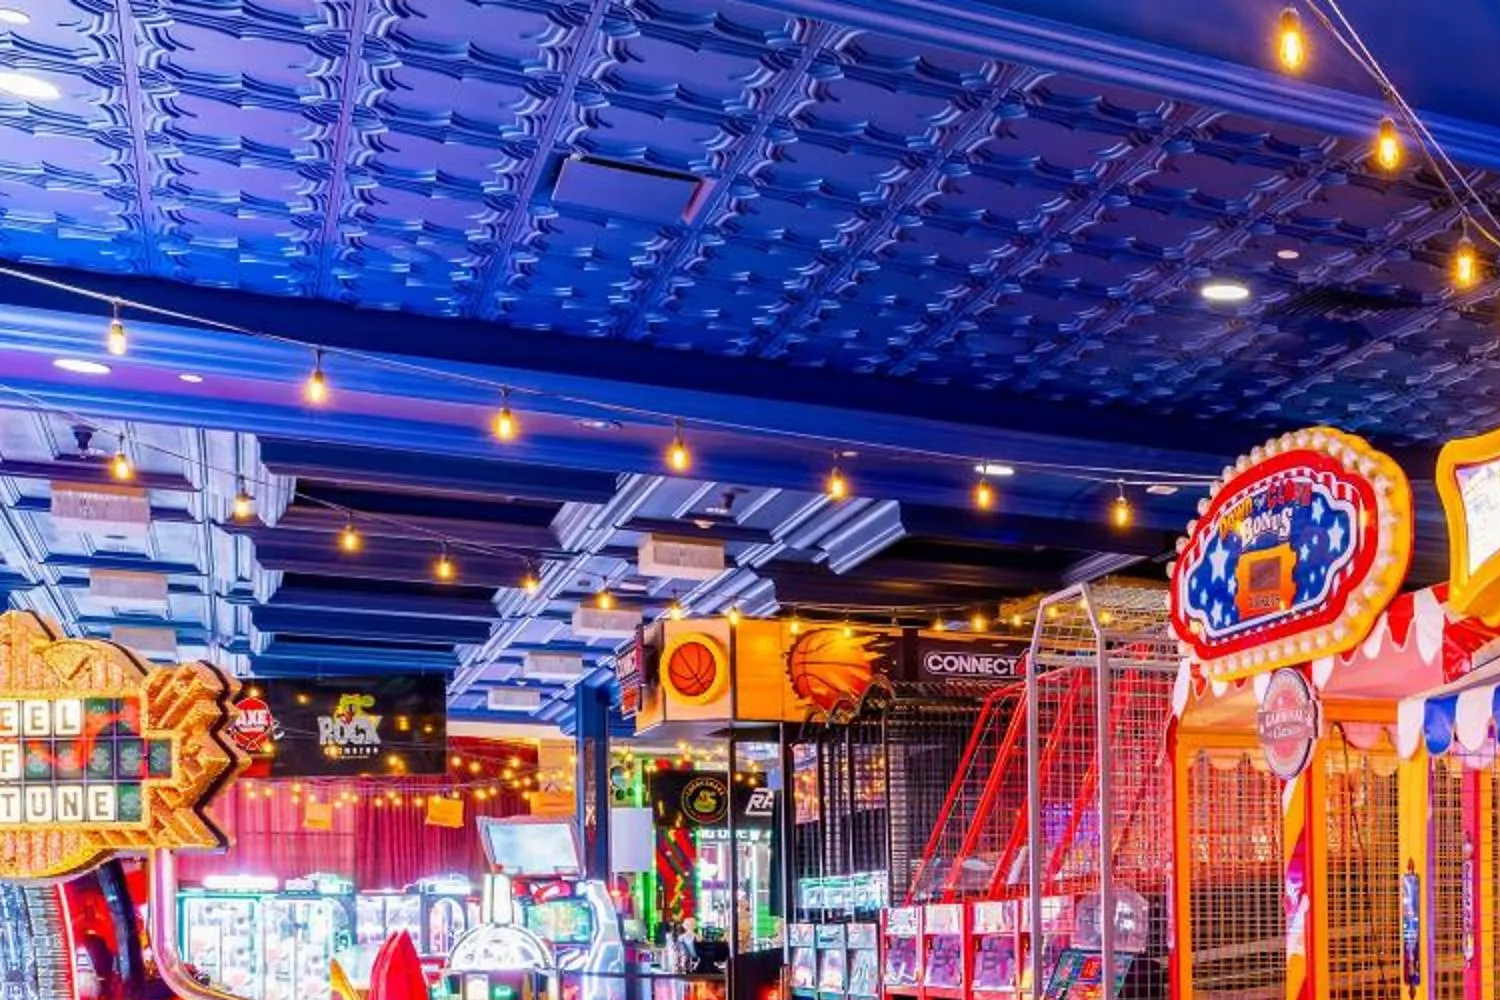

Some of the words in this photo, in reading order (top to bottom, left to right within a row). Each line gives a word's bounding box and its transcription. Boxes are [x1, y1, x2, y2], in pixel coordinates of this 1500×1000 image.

[1241, 506, 1294, 550] BONUS
[927, 654, 1018, 675] CONNECT
[317, 715, 383, 745] ROCK
